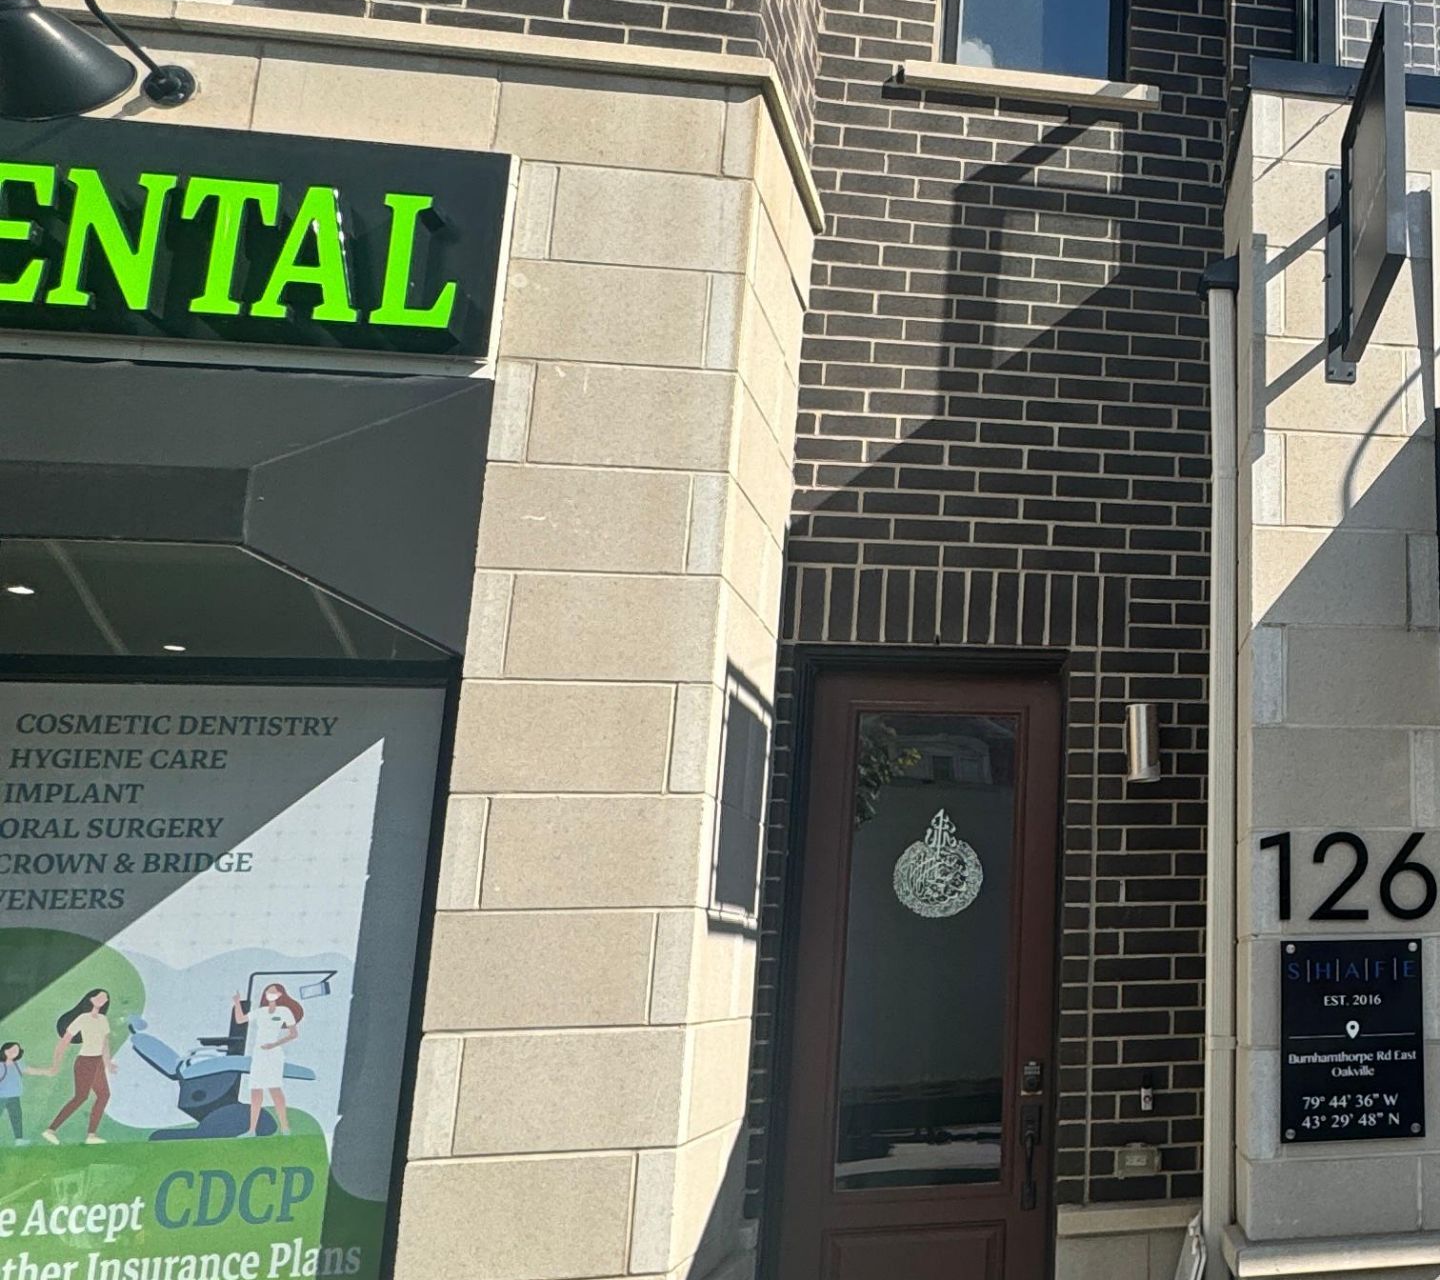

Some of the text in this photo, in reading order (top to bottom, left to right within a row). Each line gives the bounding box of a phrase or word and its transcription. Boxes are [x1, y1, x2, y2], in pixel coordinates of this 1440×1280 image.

[15, 712, 339, 737] COSMETIC DENTISTRY
[9, 748, 229, 770] HYGIENE CARE
[4, 782, 145, 804] IMPLANT
[0, 817, 224, 839] ORAL SURGERY
[113, 852, 136, 874] &
[141, 851, 254, 873] BRIDGE
[1259, 831, 1438, 921] 126
[1323, 993, 1382, 1007] EST. 2016
[1288, 1049, 1417, 1065] Burnhamthorpe Rd East
[1331, 1064, 1375, 1078] Oakville
[1383, 1092, 1399, 1106] W
[1388, 1111, 1400, 1126] N
[20, 1195, 146, 1243] Accept
[154, 1166, 315, 1230] CDCP
[267, 1236, 362, 1280] Plans
